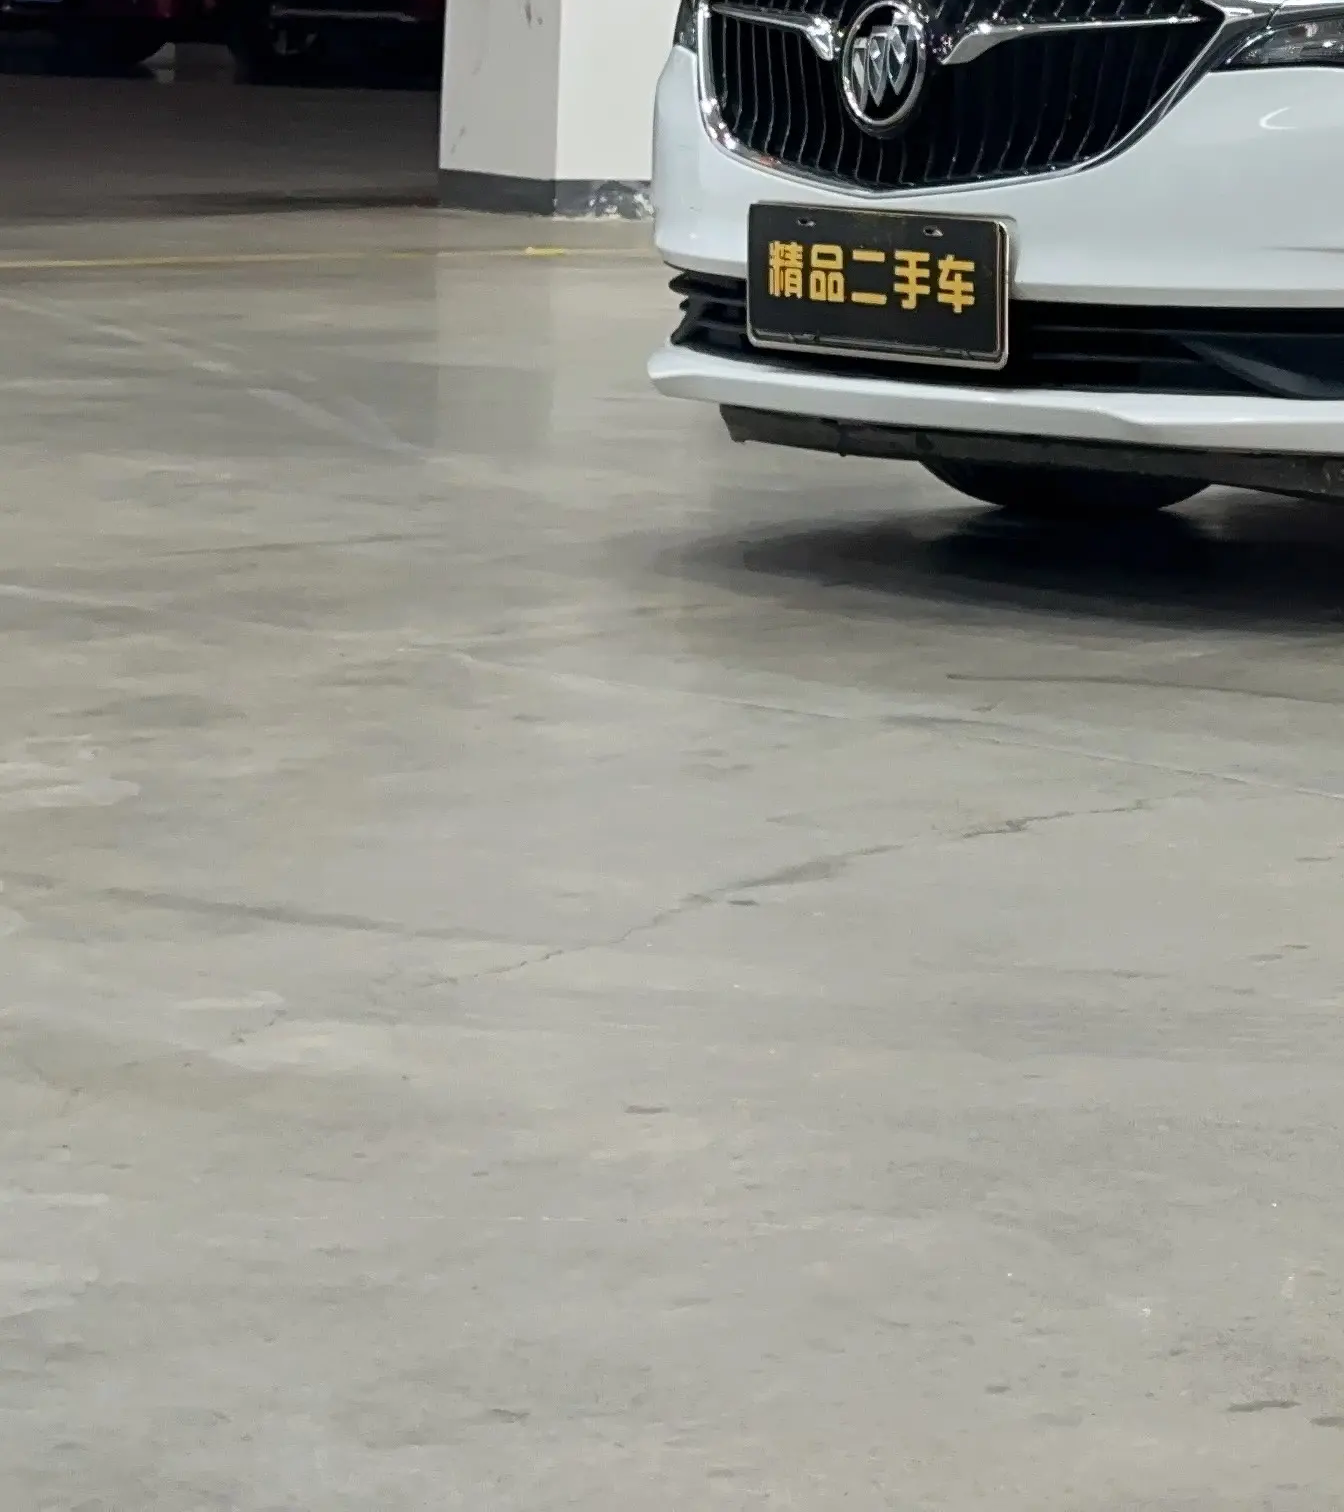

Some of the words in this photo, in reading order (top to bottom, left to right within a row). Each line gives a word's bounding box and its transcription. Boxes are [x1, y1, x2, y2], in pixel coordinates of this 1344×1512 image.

[768, 239, 976, 314] 精品二手车
